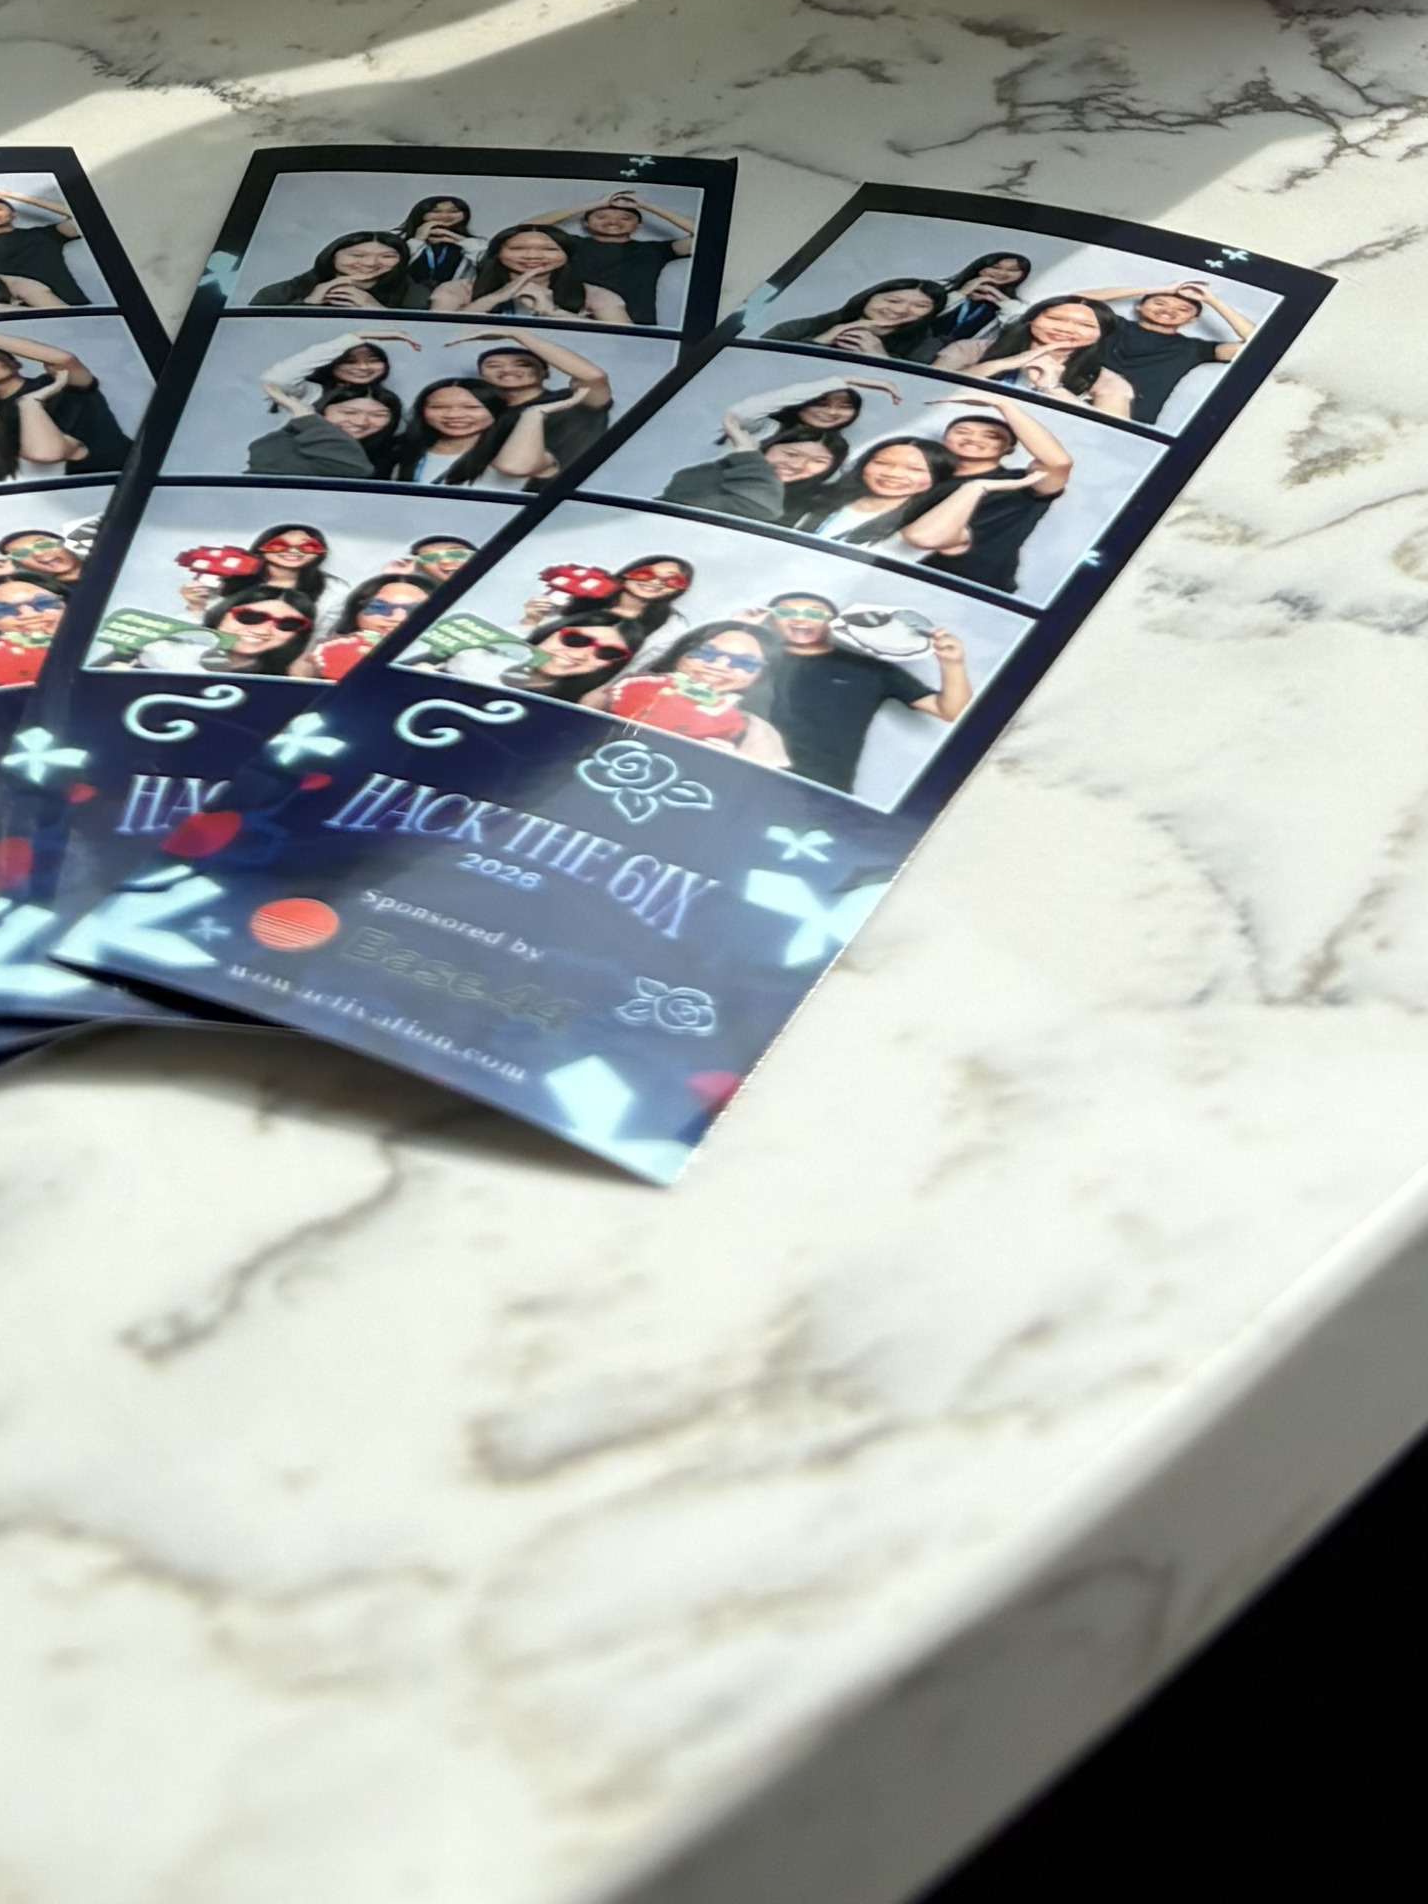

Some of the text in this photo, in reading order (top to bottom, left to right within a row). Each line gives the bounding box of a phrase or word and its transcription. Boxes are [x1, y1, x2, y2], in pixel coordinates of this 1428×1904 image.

[322, 773, 722, 940] HACK THE 6IX
[455, 852, 542, 890] 2026
[359, 888, 546, 962] Sponsored by
